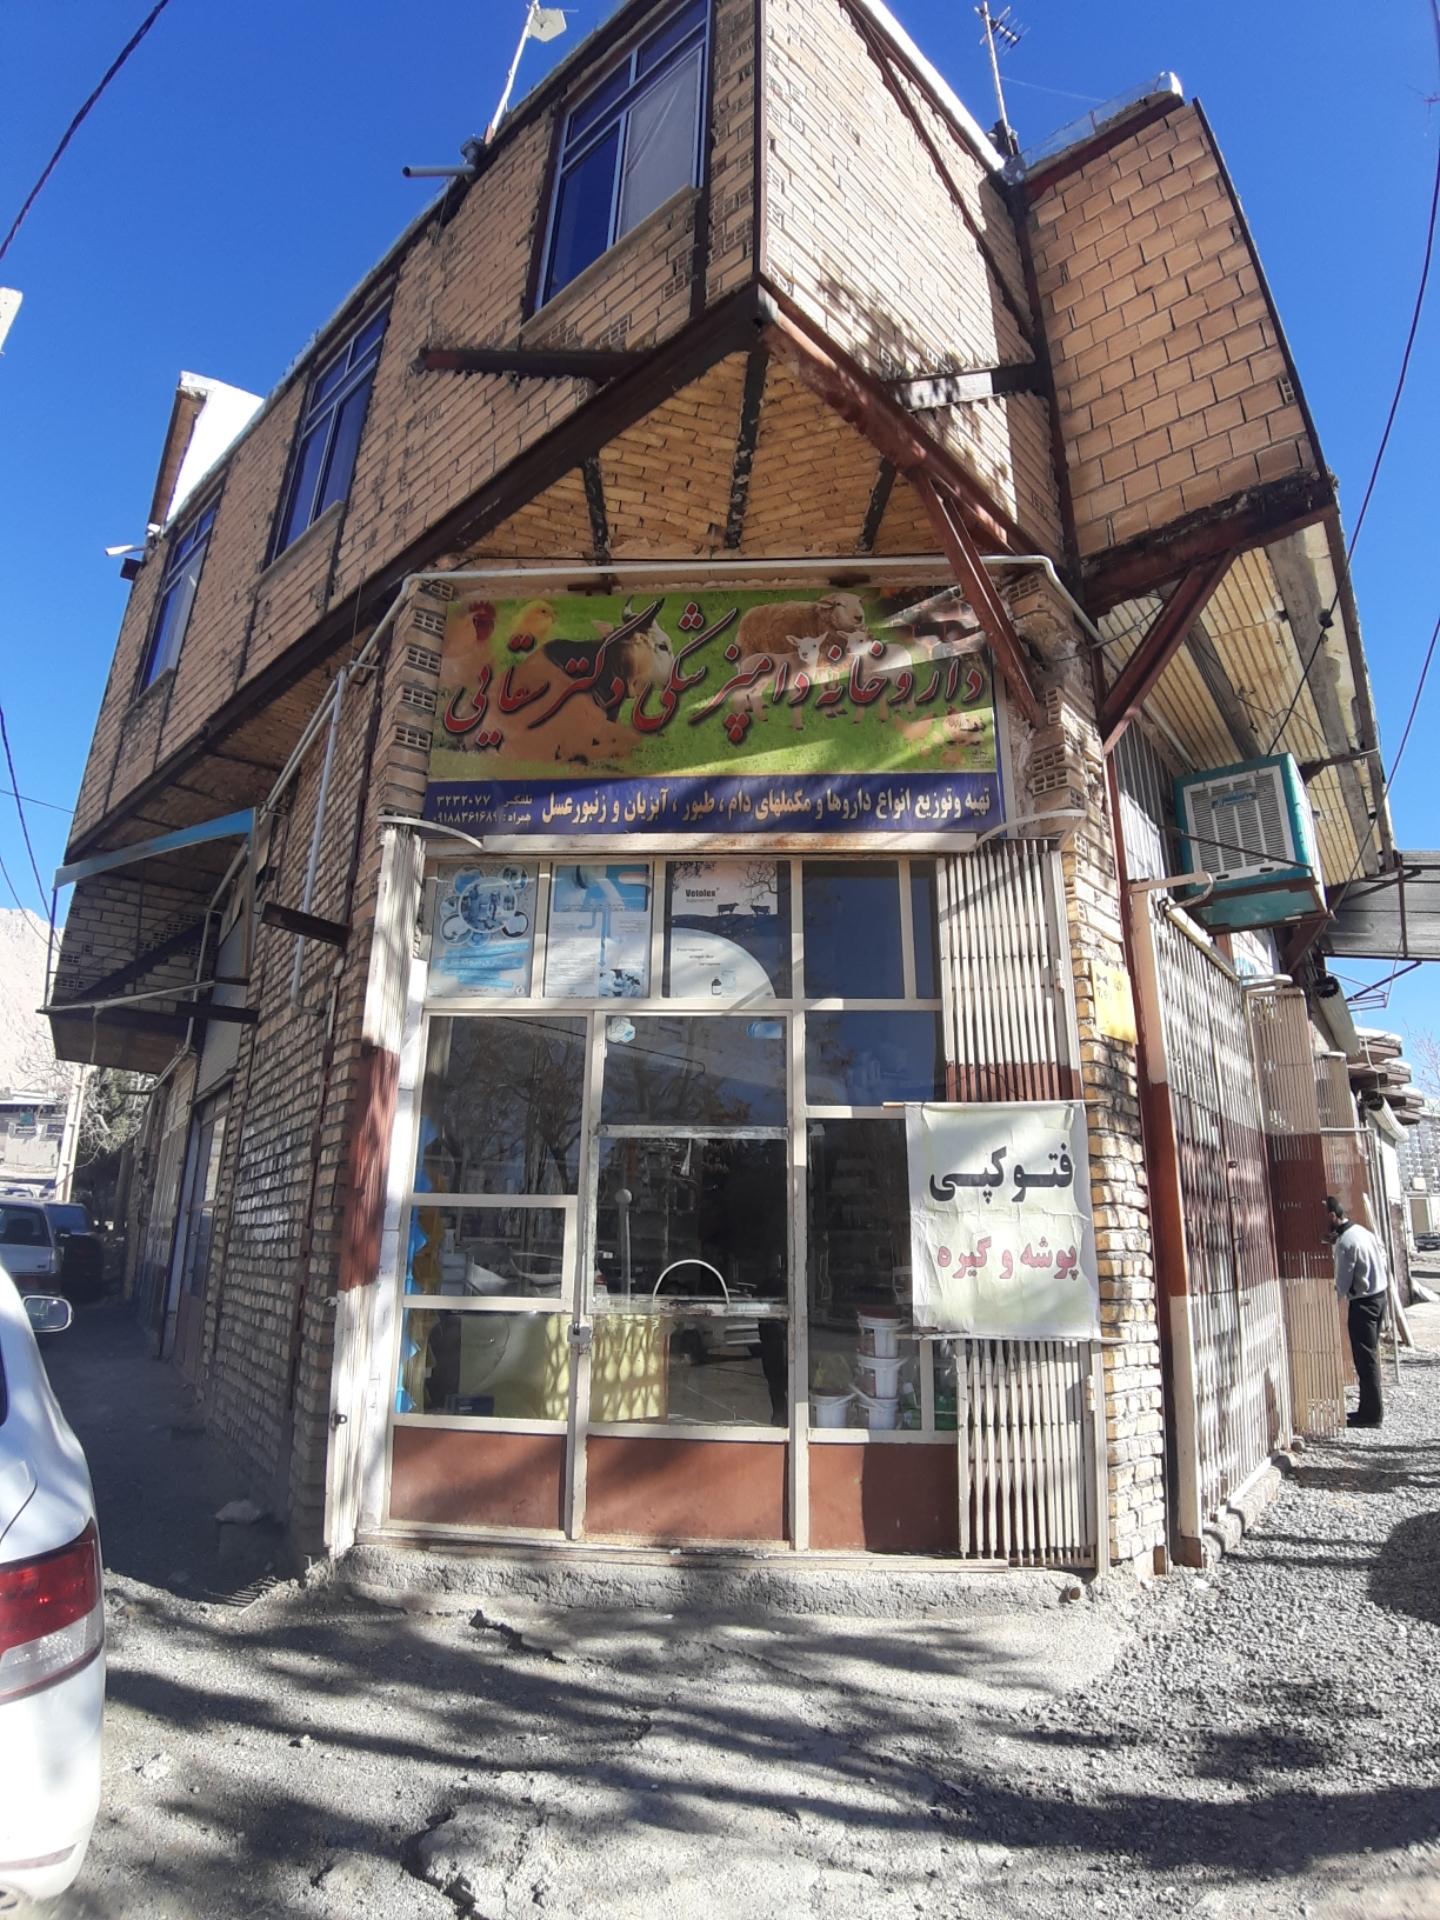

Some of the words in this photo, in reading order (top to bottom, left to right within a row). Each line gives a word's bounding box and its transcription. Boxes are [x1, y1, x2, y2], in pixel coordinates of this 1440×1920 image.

[527, 597, 666, 730] دکتر
[631, 600, 811, 744] دامپزشکی
[815, 639, 984, 706] داروخانه
[610, 804, 620, 823] و
[623, 787, 670, 822] آبزیان
[754, 788, 812, 821] مکملهای
[815, 799, 824, 820] و
[826, 787, 872, 819] داروها
[875, 787, 911, 819] انواع
[964, 787, 991, 816] تهیه
[999, 1249, 1014, 1280] و
[1020, 1236, 1079, 1281] پوشه
